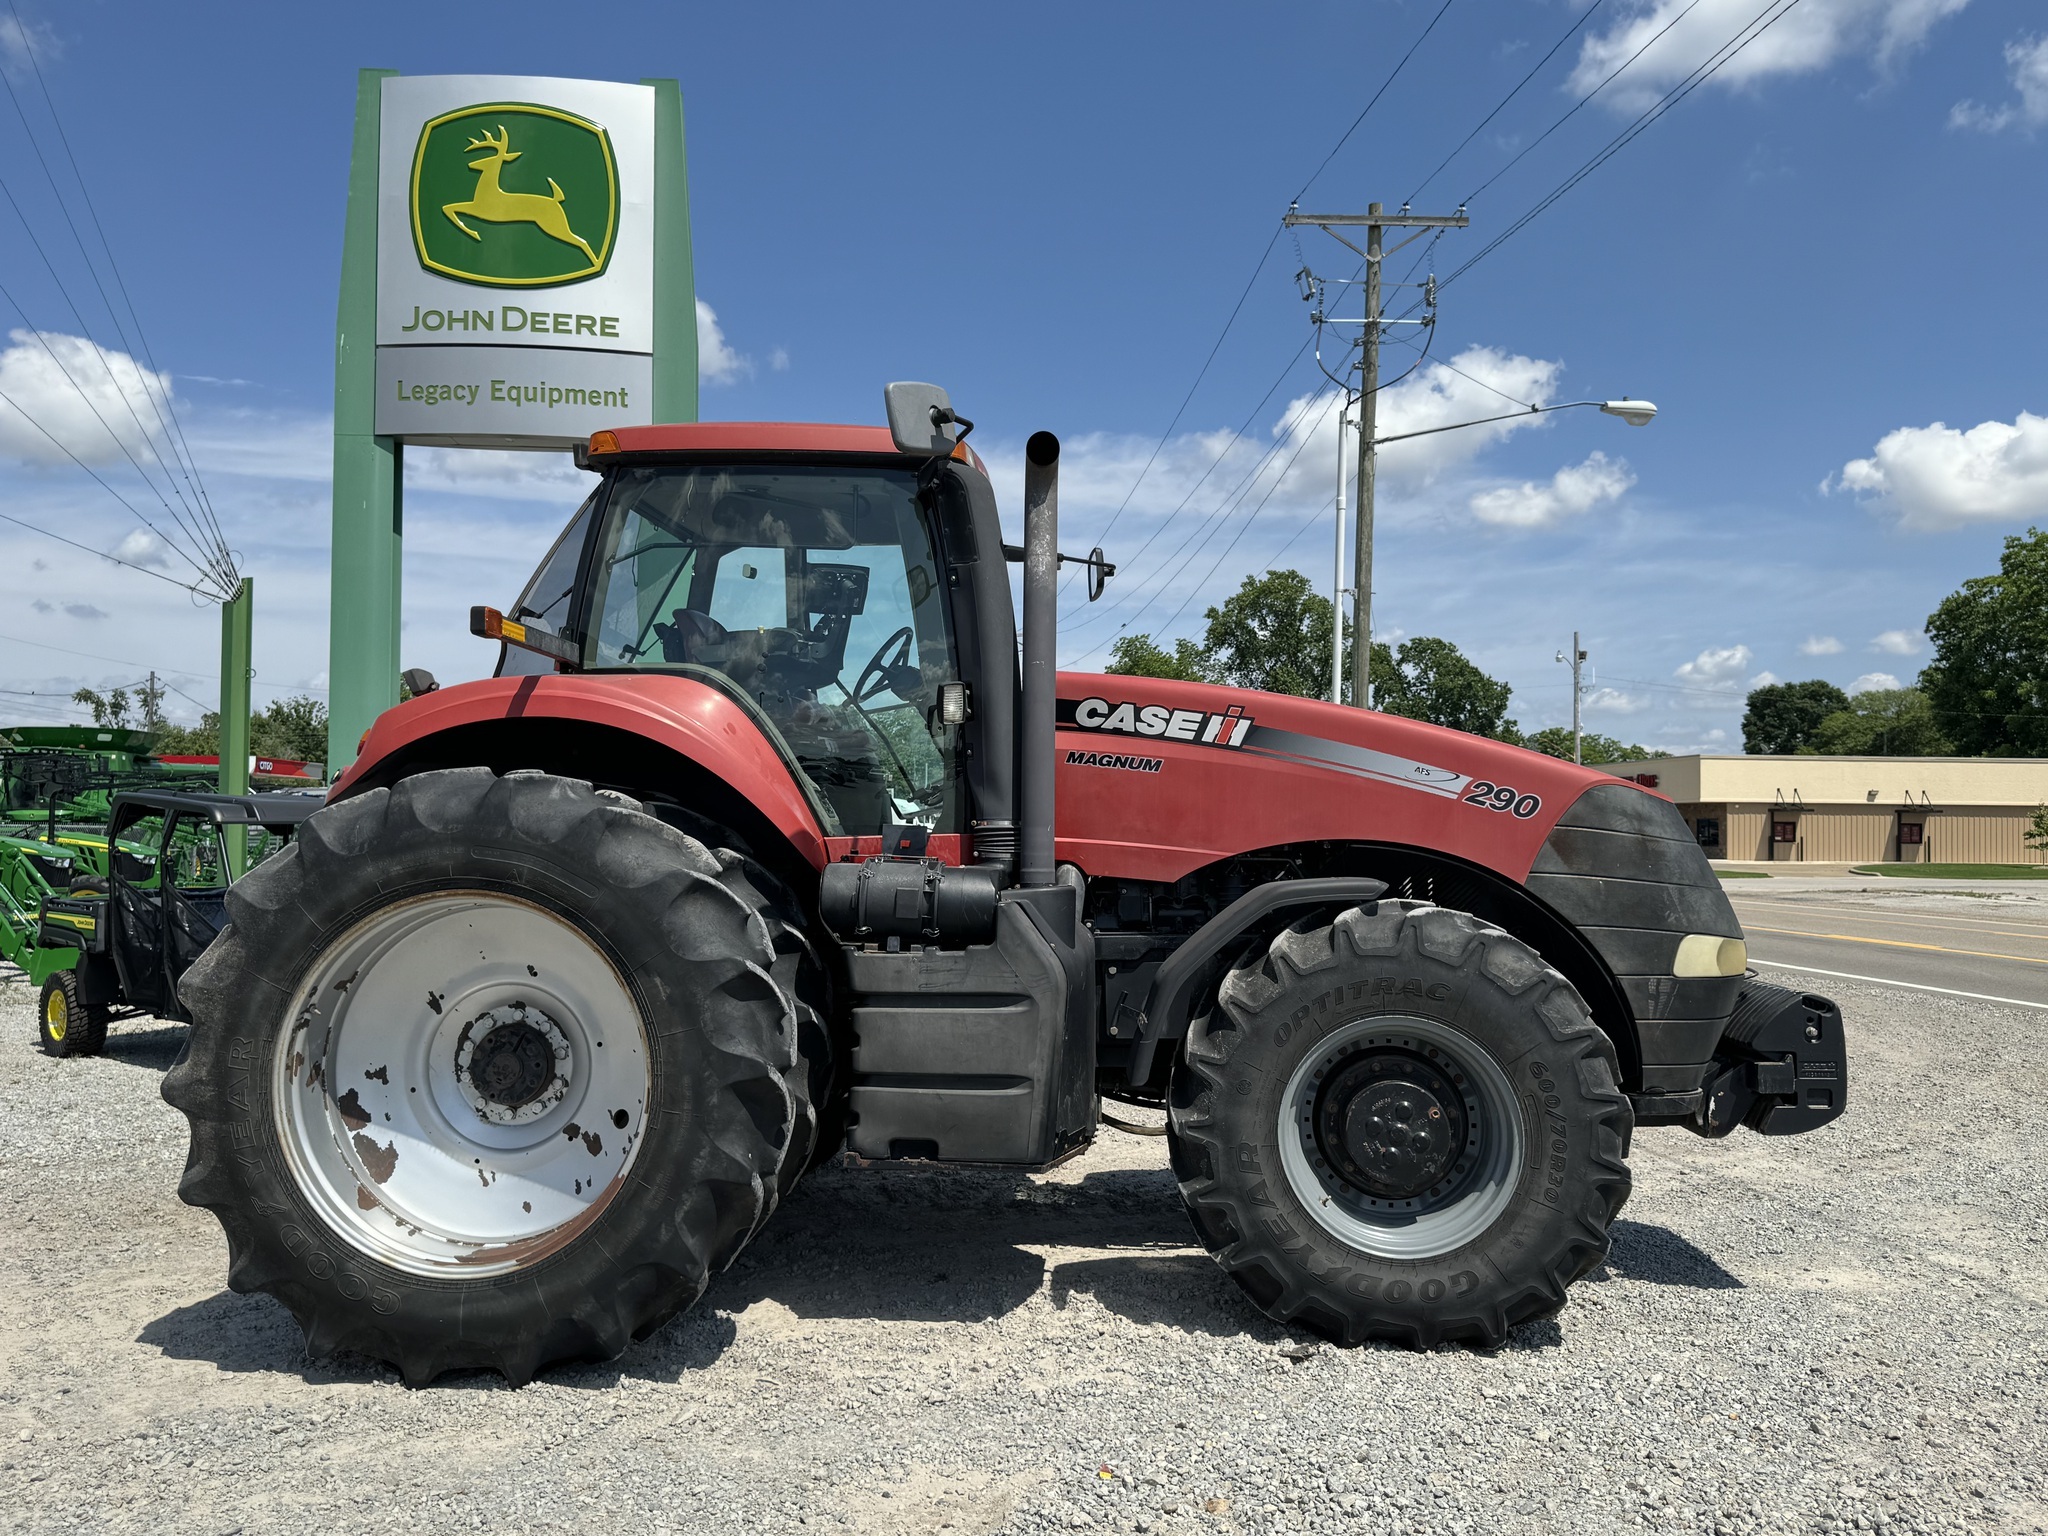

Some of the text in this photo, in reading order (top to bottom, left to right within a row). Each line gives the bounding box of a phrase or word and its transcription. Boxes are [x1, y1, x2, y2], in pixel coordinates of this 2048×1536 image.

[402, 306, 620, 338] JOHN DEERE
[398, 379, 629, 408] Legacy Equipment
[1075, 698, 1203, 741] CASE
[1065, 751, 1164, 773] MAGNUM
[1414, 766, 1431, 776] AFS
[1462, 780, 1542, 819] 290
[1273, 976, 1452, 1048] OPTITRAC
[1529, 1061, 1569, 1204] 600/70R30
[228, 1036, 401, 1316] GOODYEAR
[1236, 1142, 1480, 1304] GOODYEAR
